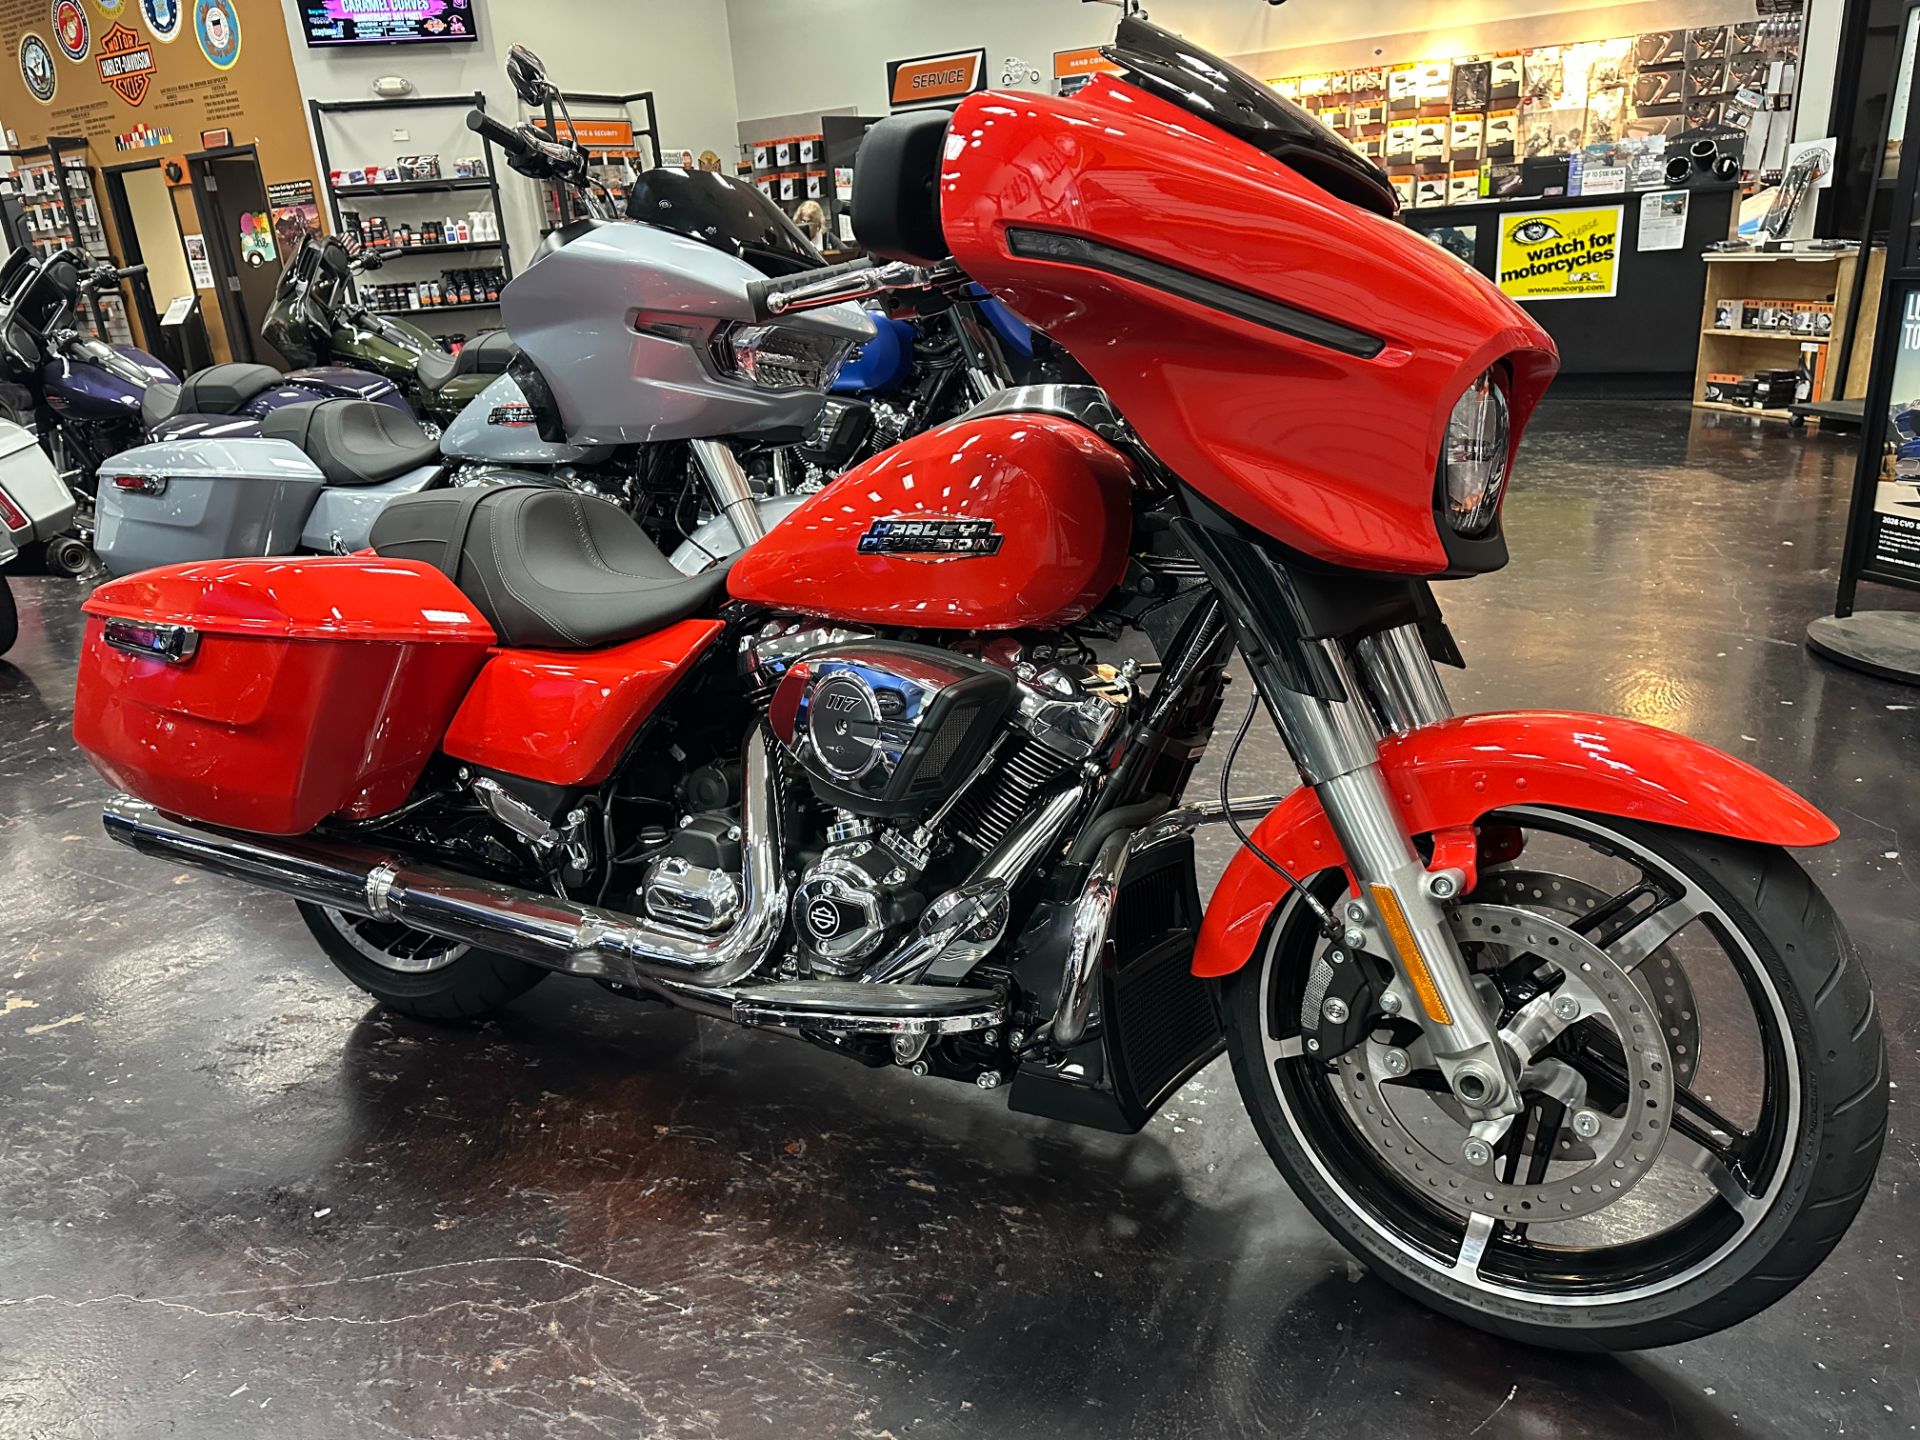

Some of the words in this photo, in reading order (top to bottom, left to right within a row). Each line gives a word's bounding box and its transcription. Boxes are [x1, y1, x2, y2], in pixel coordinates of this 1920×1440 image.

[108, 31, 135, 52] MOTOR
[100, 51, 152, 77] HARLEY-DAVIDSON
[1070, 58, 1089, 66] HAND
[118, 76, 144, 98] CYCLES
[912, 69, 964, 89] SERVICE
[1566, 219, 1599, 240] please
[1527, 239, 1585, 261] watch
[1589, 232, 1615, 249] for
[1501, 248, 1615, 283] motorcycles
[1569, 272, 1599, 282] MAC
[1528, 284, 1605, 293] www.macorg.com
[1900, 519, 1915, 529] CVO
[862, 537, 996, 550] DAVIDSON
[826, 693, 862, 713] 117
